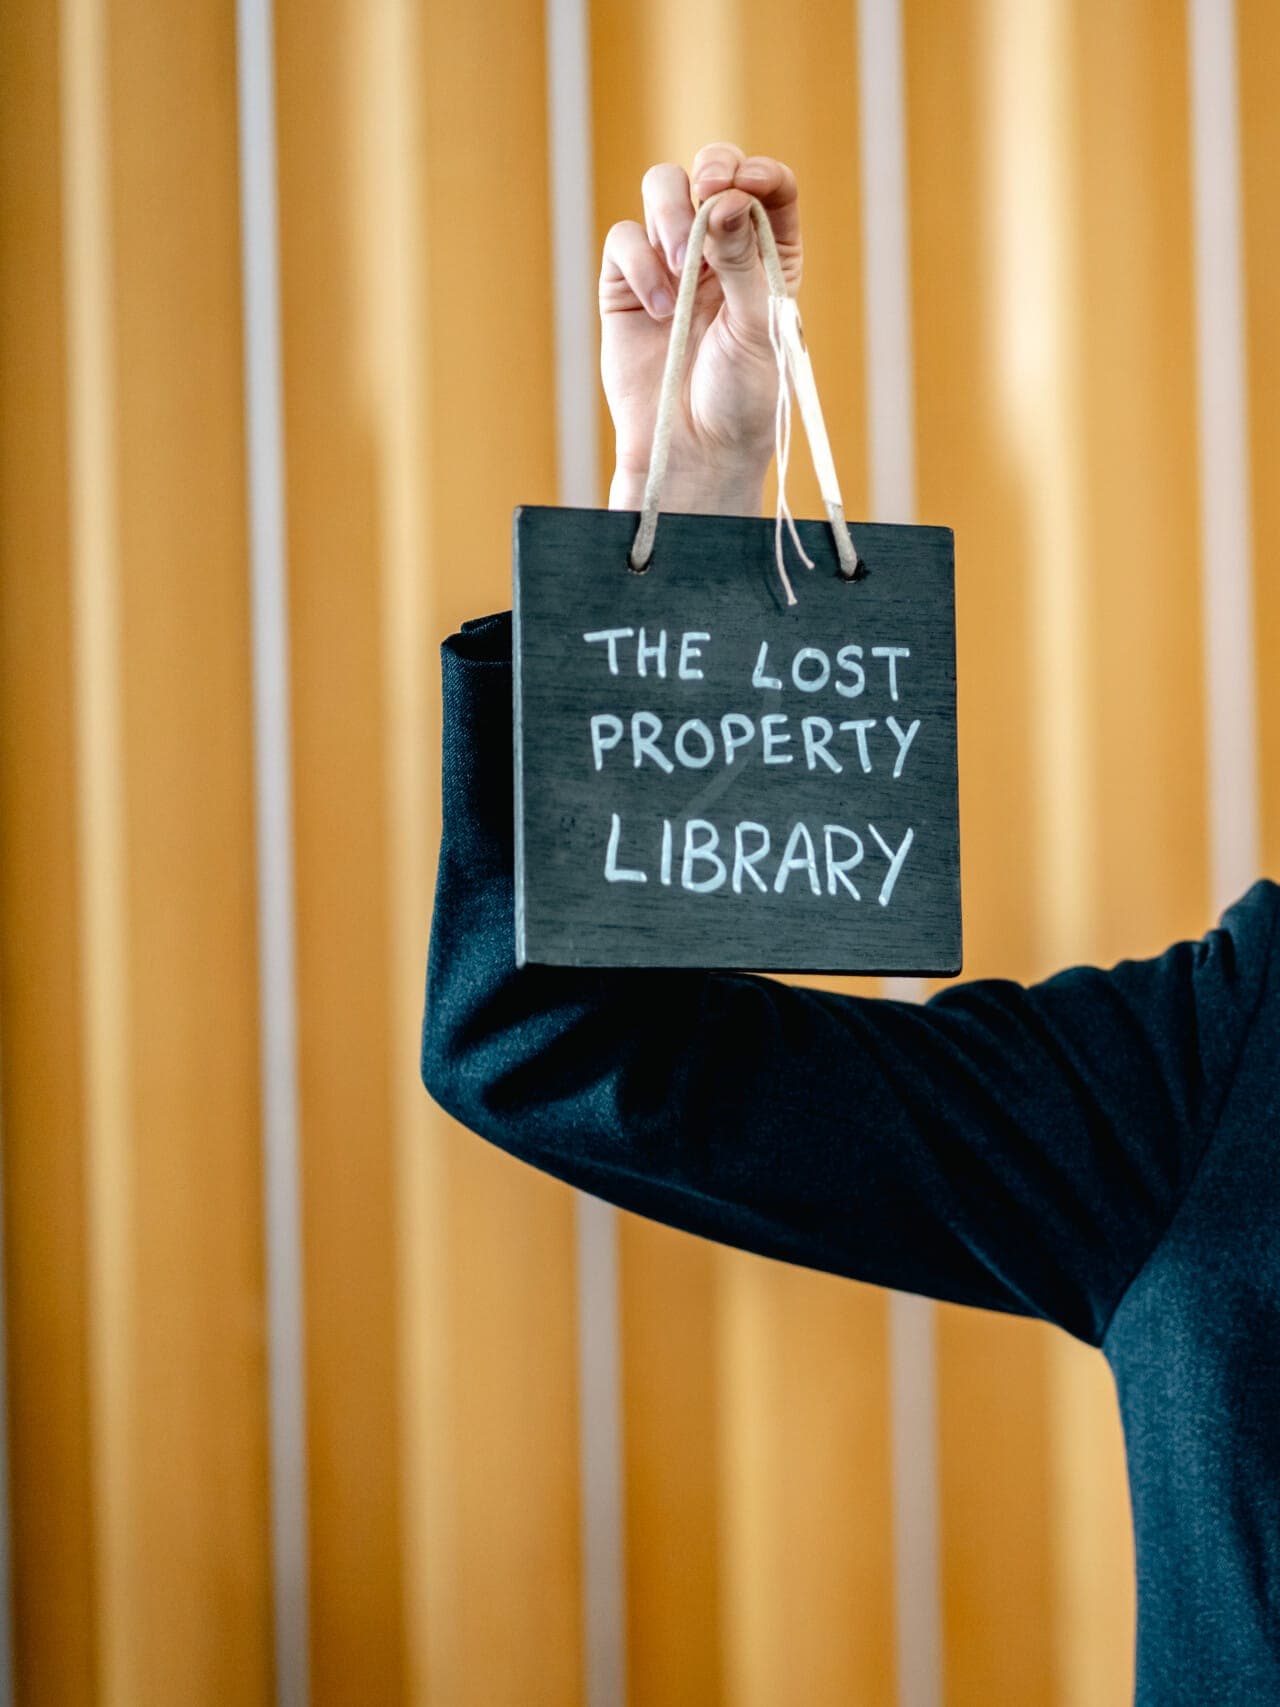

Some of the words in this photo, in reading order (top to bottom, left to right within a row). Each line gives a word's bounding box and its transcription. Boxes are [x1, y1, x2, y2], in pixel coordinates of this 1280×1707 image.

[583, 627, 711, 680] THE
[751, 641, 910, 702] LOST
[590, 711, 921, 779] PROPERTY
[604, 813, 915, 907] LIBRARY
